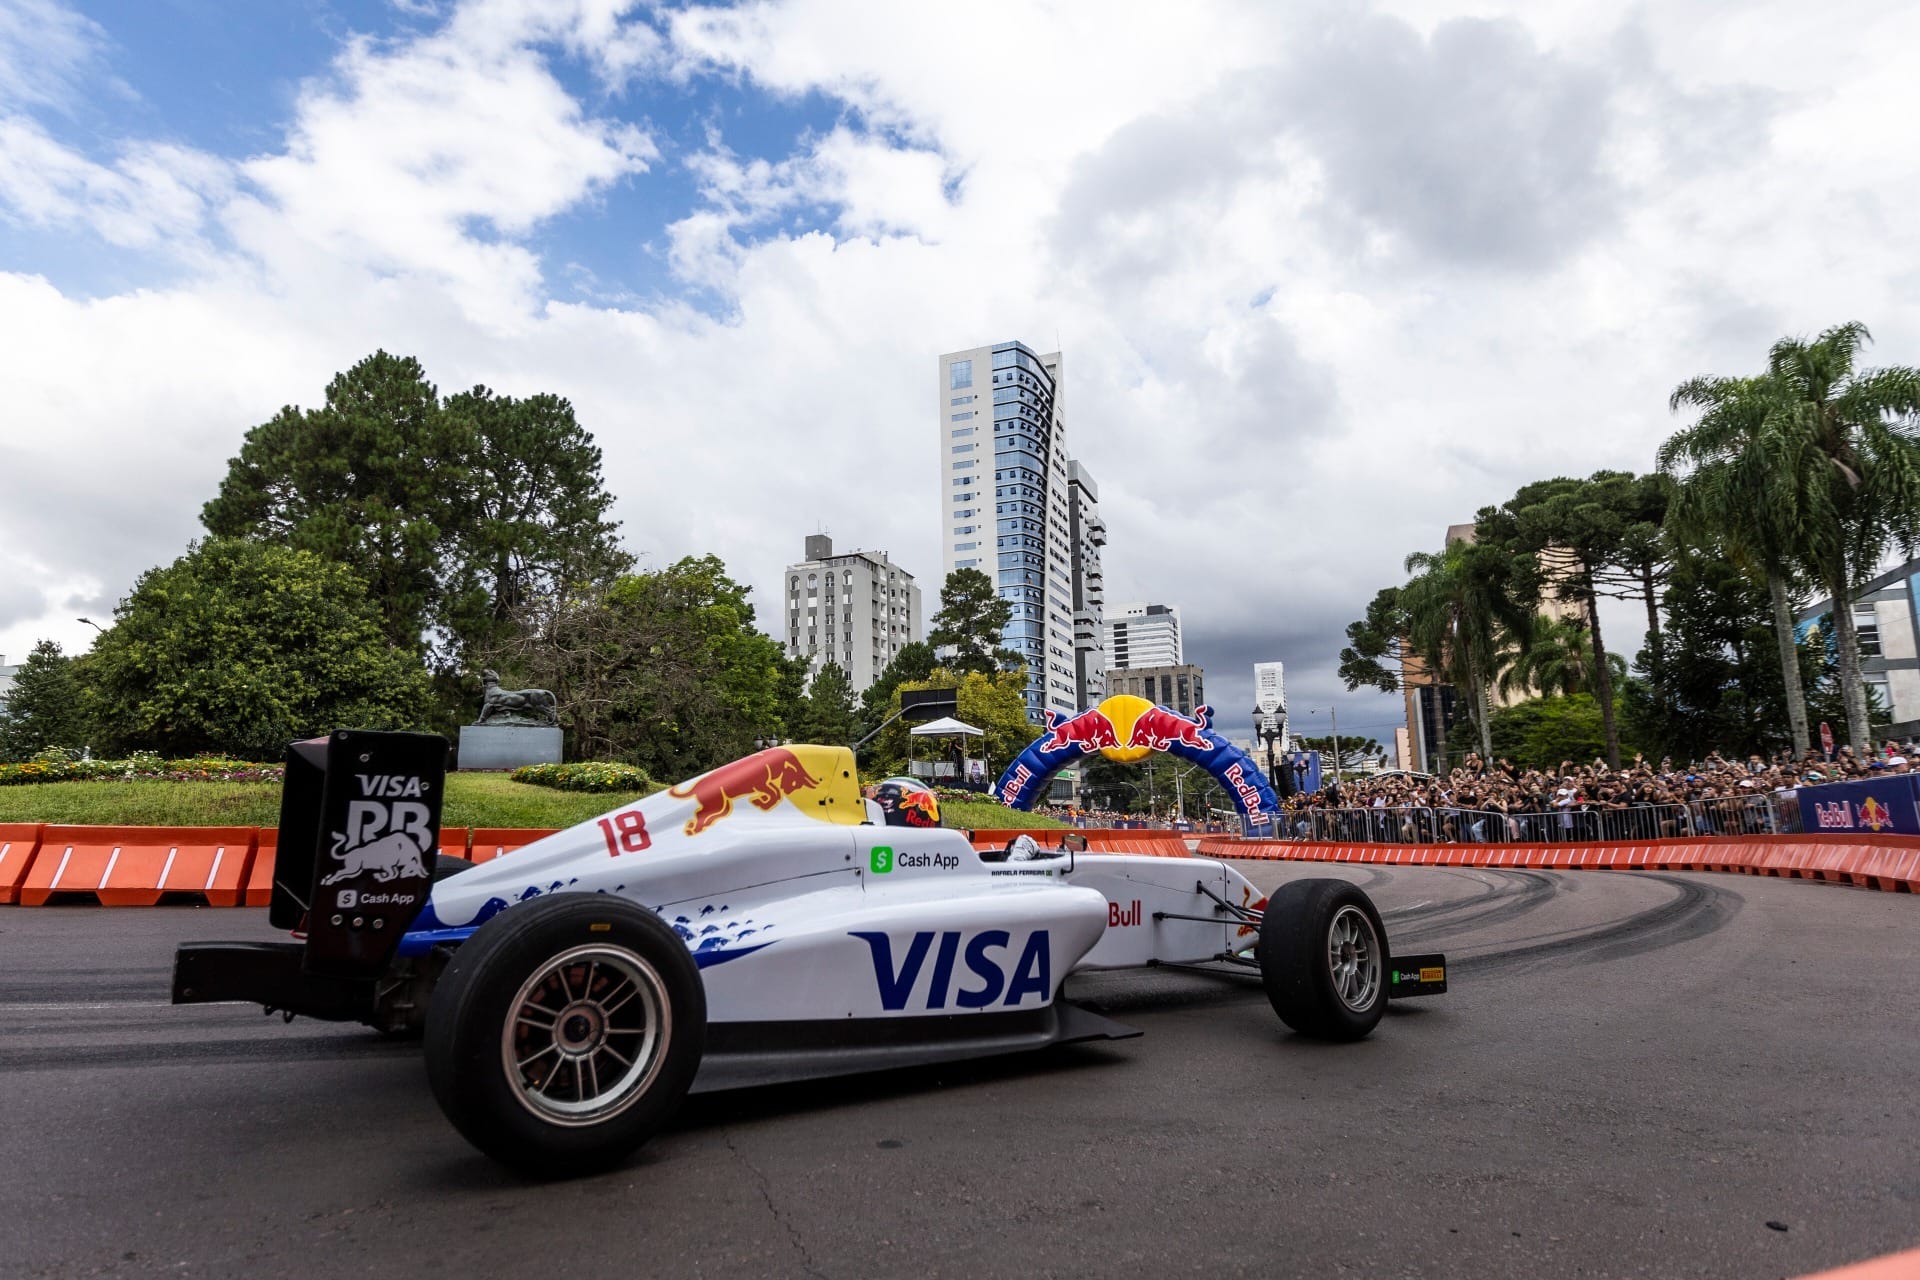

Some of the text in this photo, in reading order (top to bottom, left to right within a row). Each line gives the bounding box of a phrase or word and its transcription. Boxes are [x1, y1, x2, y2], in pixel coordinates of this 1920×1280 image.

[354, 774, 422, 798] VISA
[344, 800, 433, 853] RB
[597, 810, 652, 857] 18
[898, 853, 931, 867] Cash
[933, 853, 960, 870] App
[360, 892, 389, 904] Cash
[391, 893, 415, 905] App
[1108, 899, 1142, 928] Bull
[847, 930, 1051, 1011] VISA
